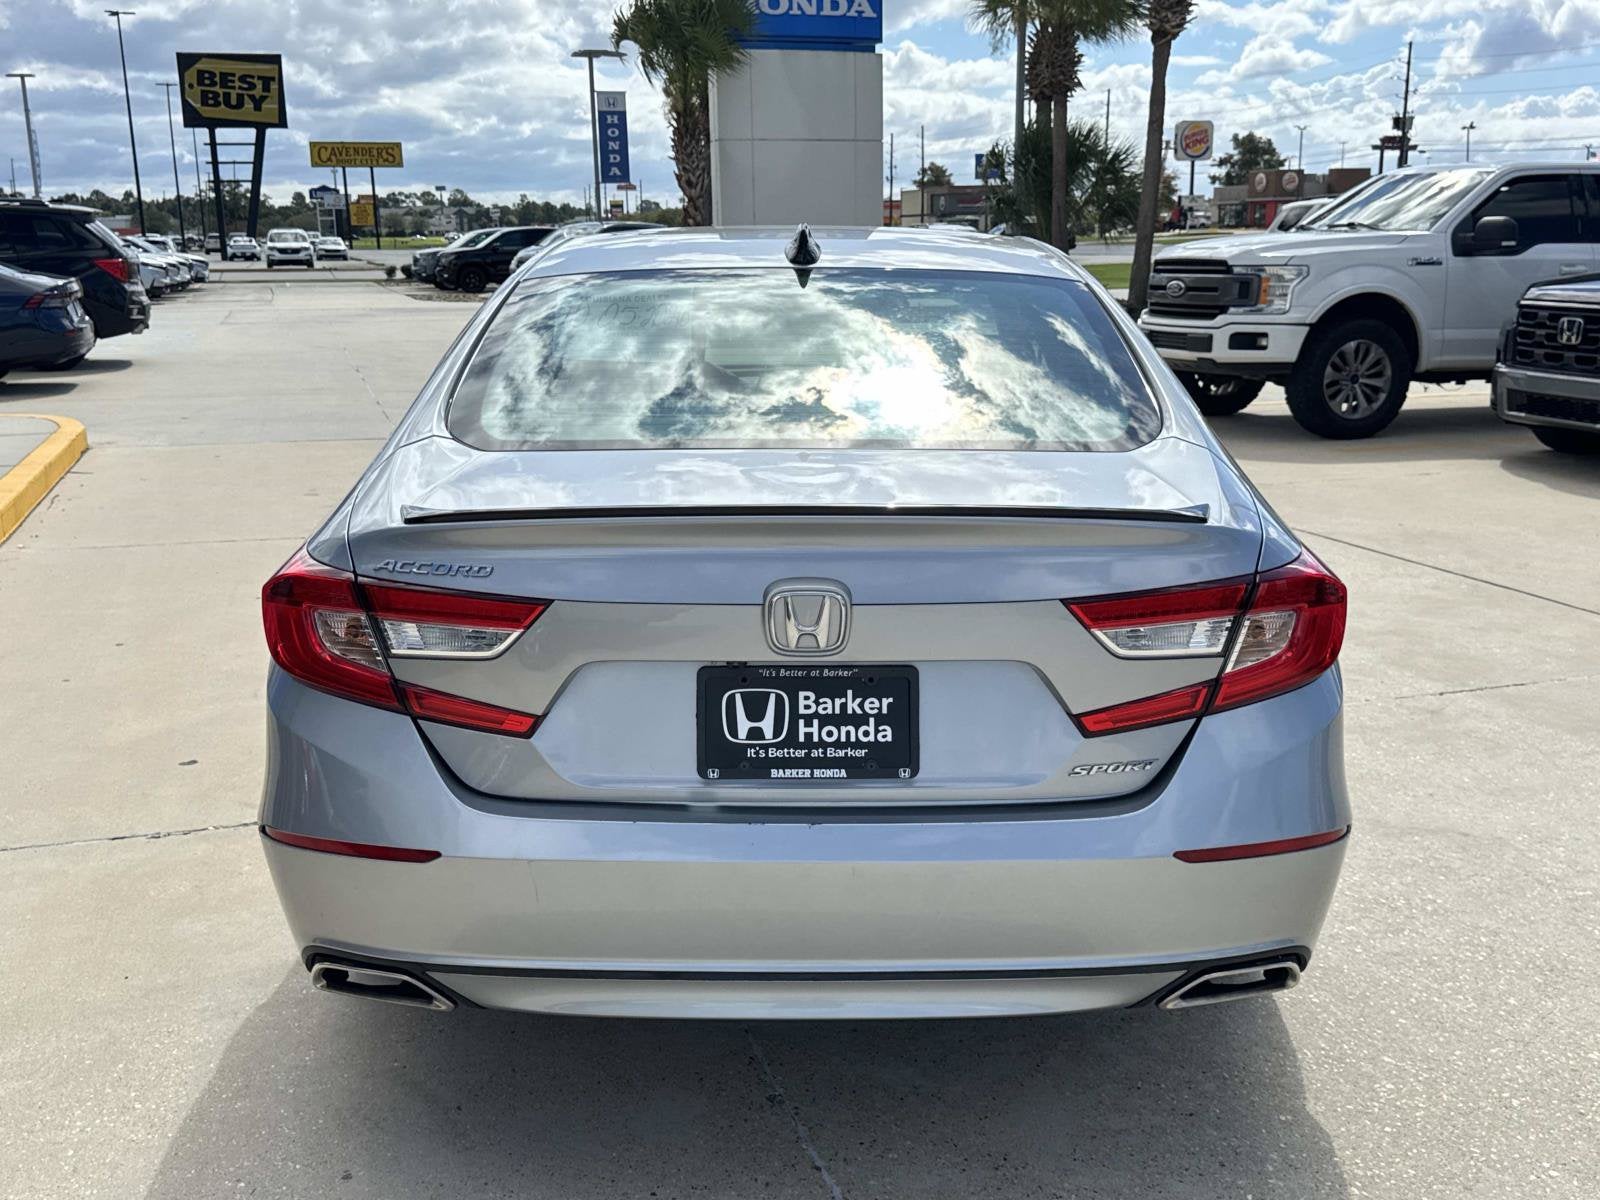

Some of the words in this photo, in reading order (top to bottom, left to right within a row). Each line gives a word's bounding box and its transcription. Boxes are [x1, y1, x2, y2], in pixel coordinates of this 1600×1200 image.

[746, 0, 877, 18] ONDA
[196, 69, 276, 93] BEST
[200, 90, 269, 112] BUY
[317, 145, 396, 164] CAVENDER'S
[606, 114, 621, 176] HONDA
[373, 559, 494, 578] ACCORD
[779, 668, 807, 677] Better
[810, 668, 820, 677] at
[798, 689, 894, 715] Barker
[798, 716, 893, 743] Honda
[747, 746, 766, 758] It's
[768, 747, 808, 758] Better
[811, 748, 824, 758] at
[826, 747, 868, 758] Barker
[770, 768, 811, 778] BARKER
[813, 768, 847, 778] HONDA
[1068, 758, 1159, 777] SPORT
